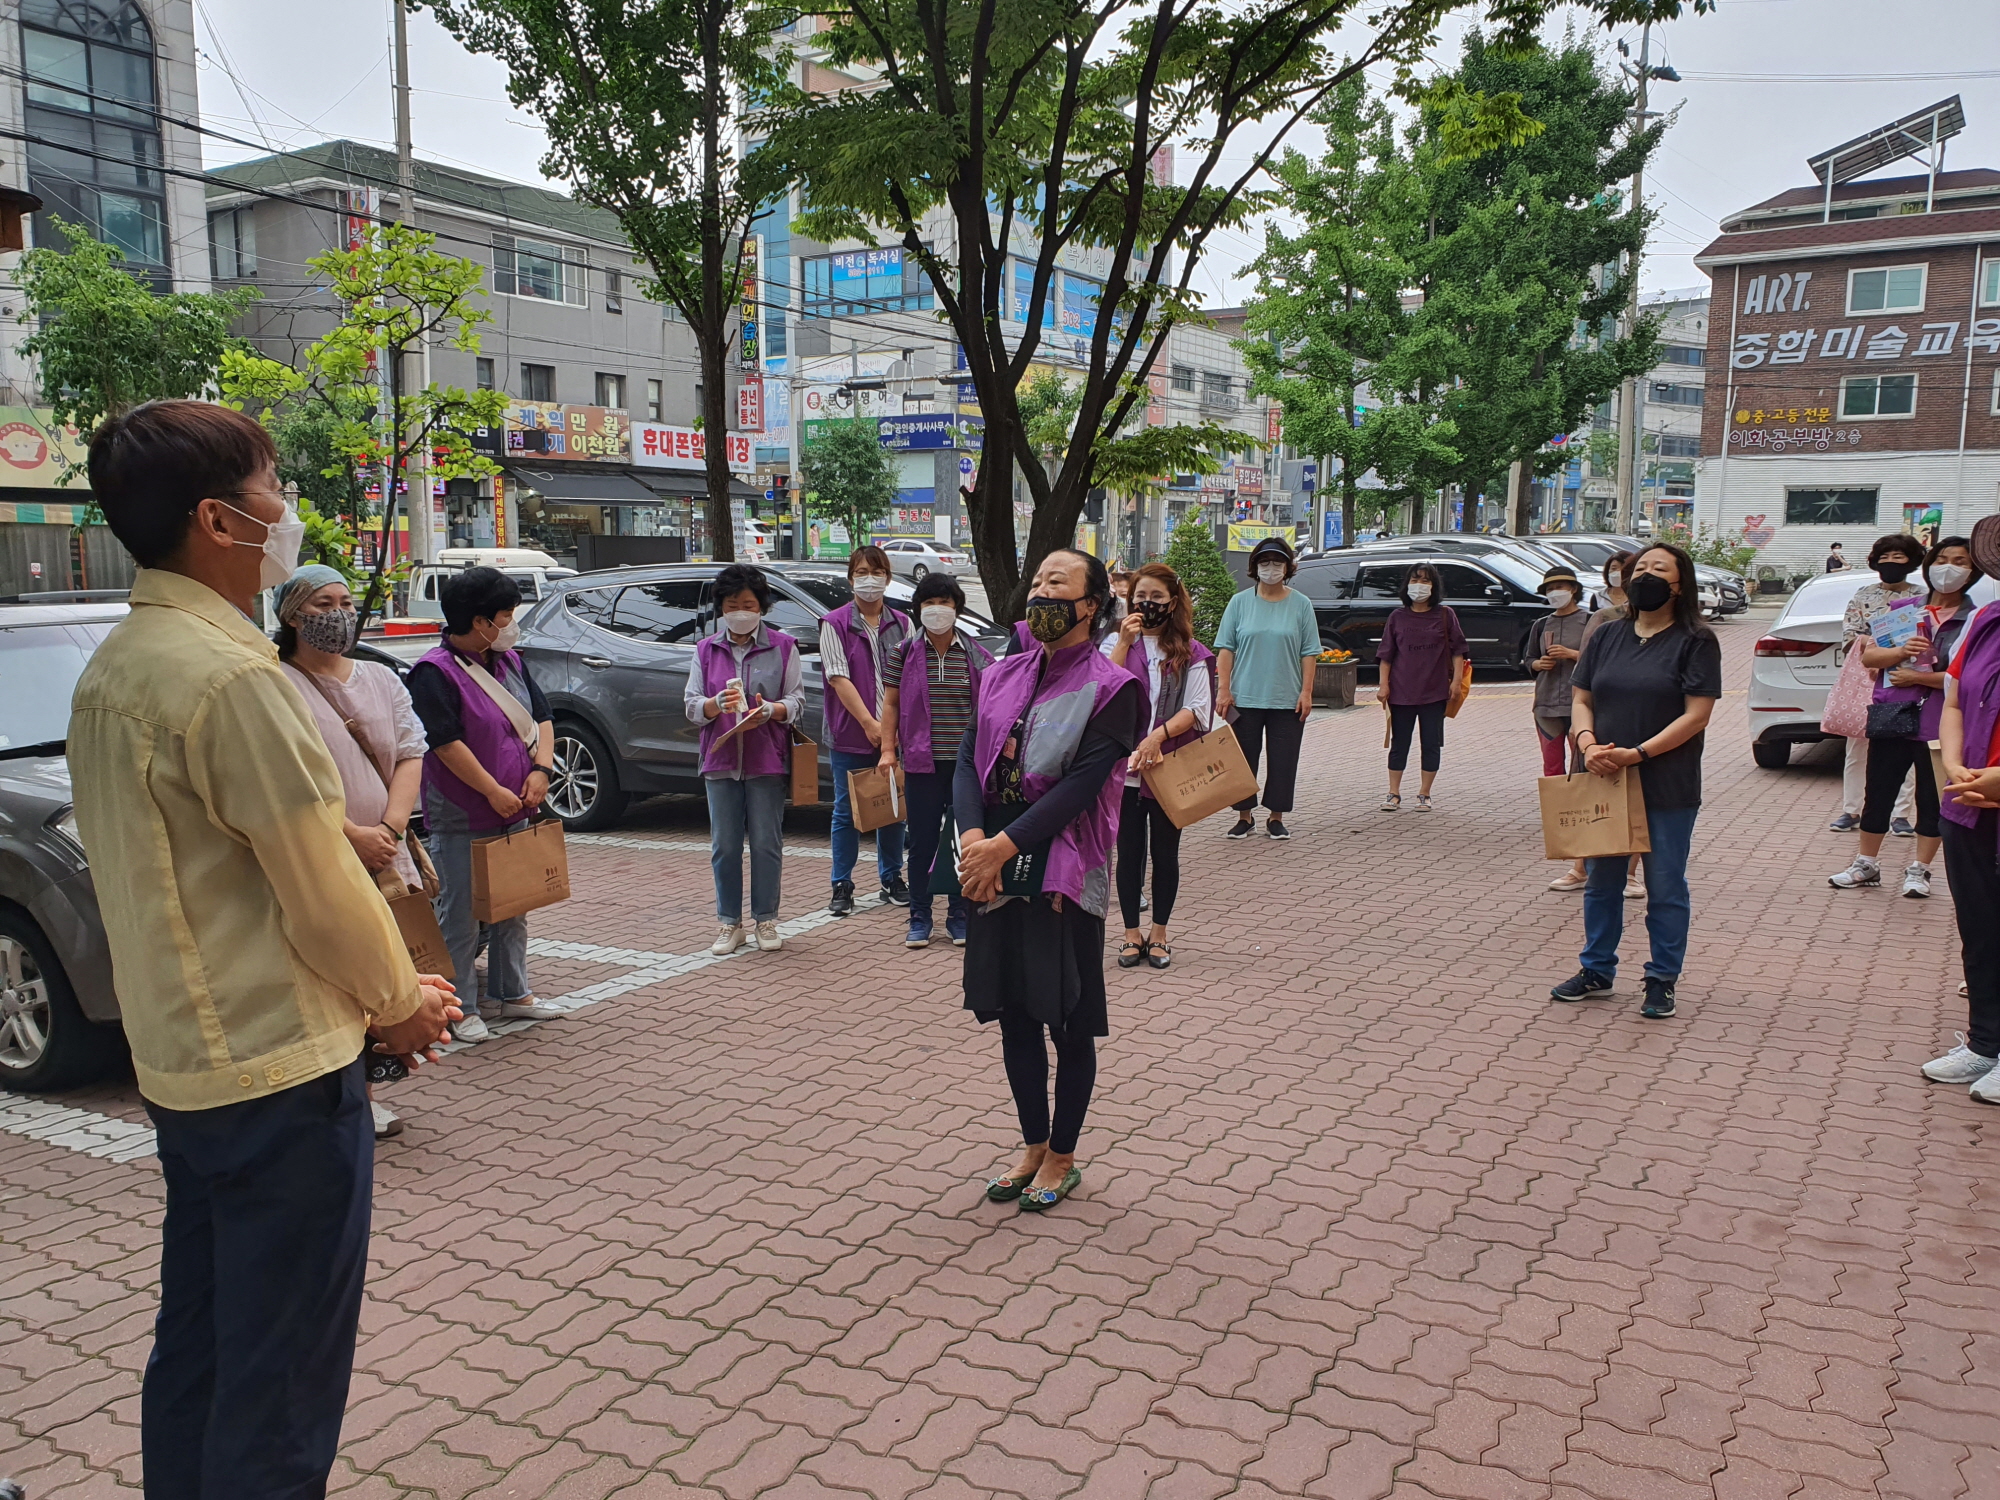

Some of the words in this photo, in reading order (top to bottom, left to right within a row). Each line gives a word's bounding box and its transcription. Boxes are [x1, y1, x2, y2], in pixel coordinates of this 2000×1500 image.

[835, 254, 855, 270] 비전
[867, 249, 900, 266] 독서실
[740, 389, 758, 407] 청년
[740, 408, 758, 426] 통신
[1803, 408, 1832, 423] 전문
[570, 434, 620, 456] 이천원
[1729, 427, 1833, 452] 이화공부방
[1835, 429, 1862, 446] 2층
[898, 509, 931, 523] 부동산
